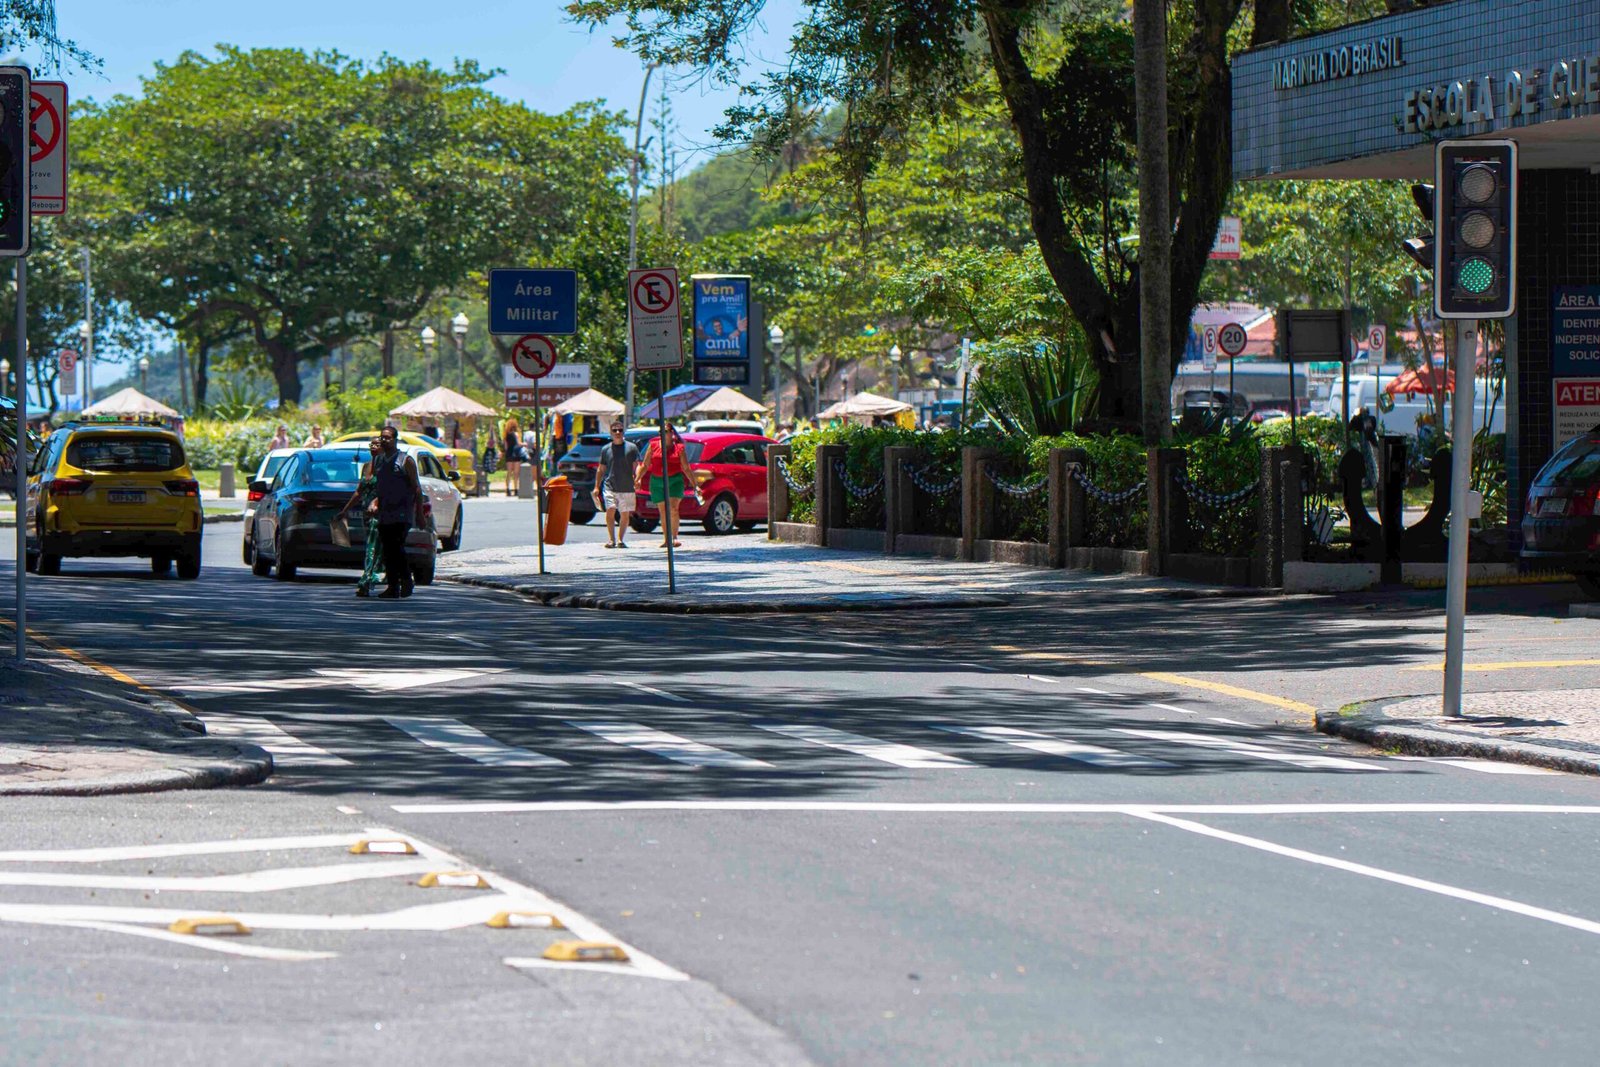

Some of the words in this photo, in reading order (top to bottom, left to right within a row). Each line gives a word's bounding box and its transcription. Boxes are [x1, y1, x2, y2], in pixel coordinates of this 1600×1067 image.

[1272, 51, 1327, 90] MARINHA
[1330, 46, 1349, 78] DO
[1352, 37, 1400, 74] BRASIL
[1404, 75, 1495, 133] ESCOLA
[1505, 68, 1539, 116] DE
[514, 279, 552, 296] Área
[701, 284, 735, 295] Vem
[1559, 293, 1595, 306] ÁREA
[507, 308, 559, 320] Militar
[705, 336, 741, 349] amil
[1224, 331, 1242, 343] 20
[1569, 350, 1600, 360] SOLIC
